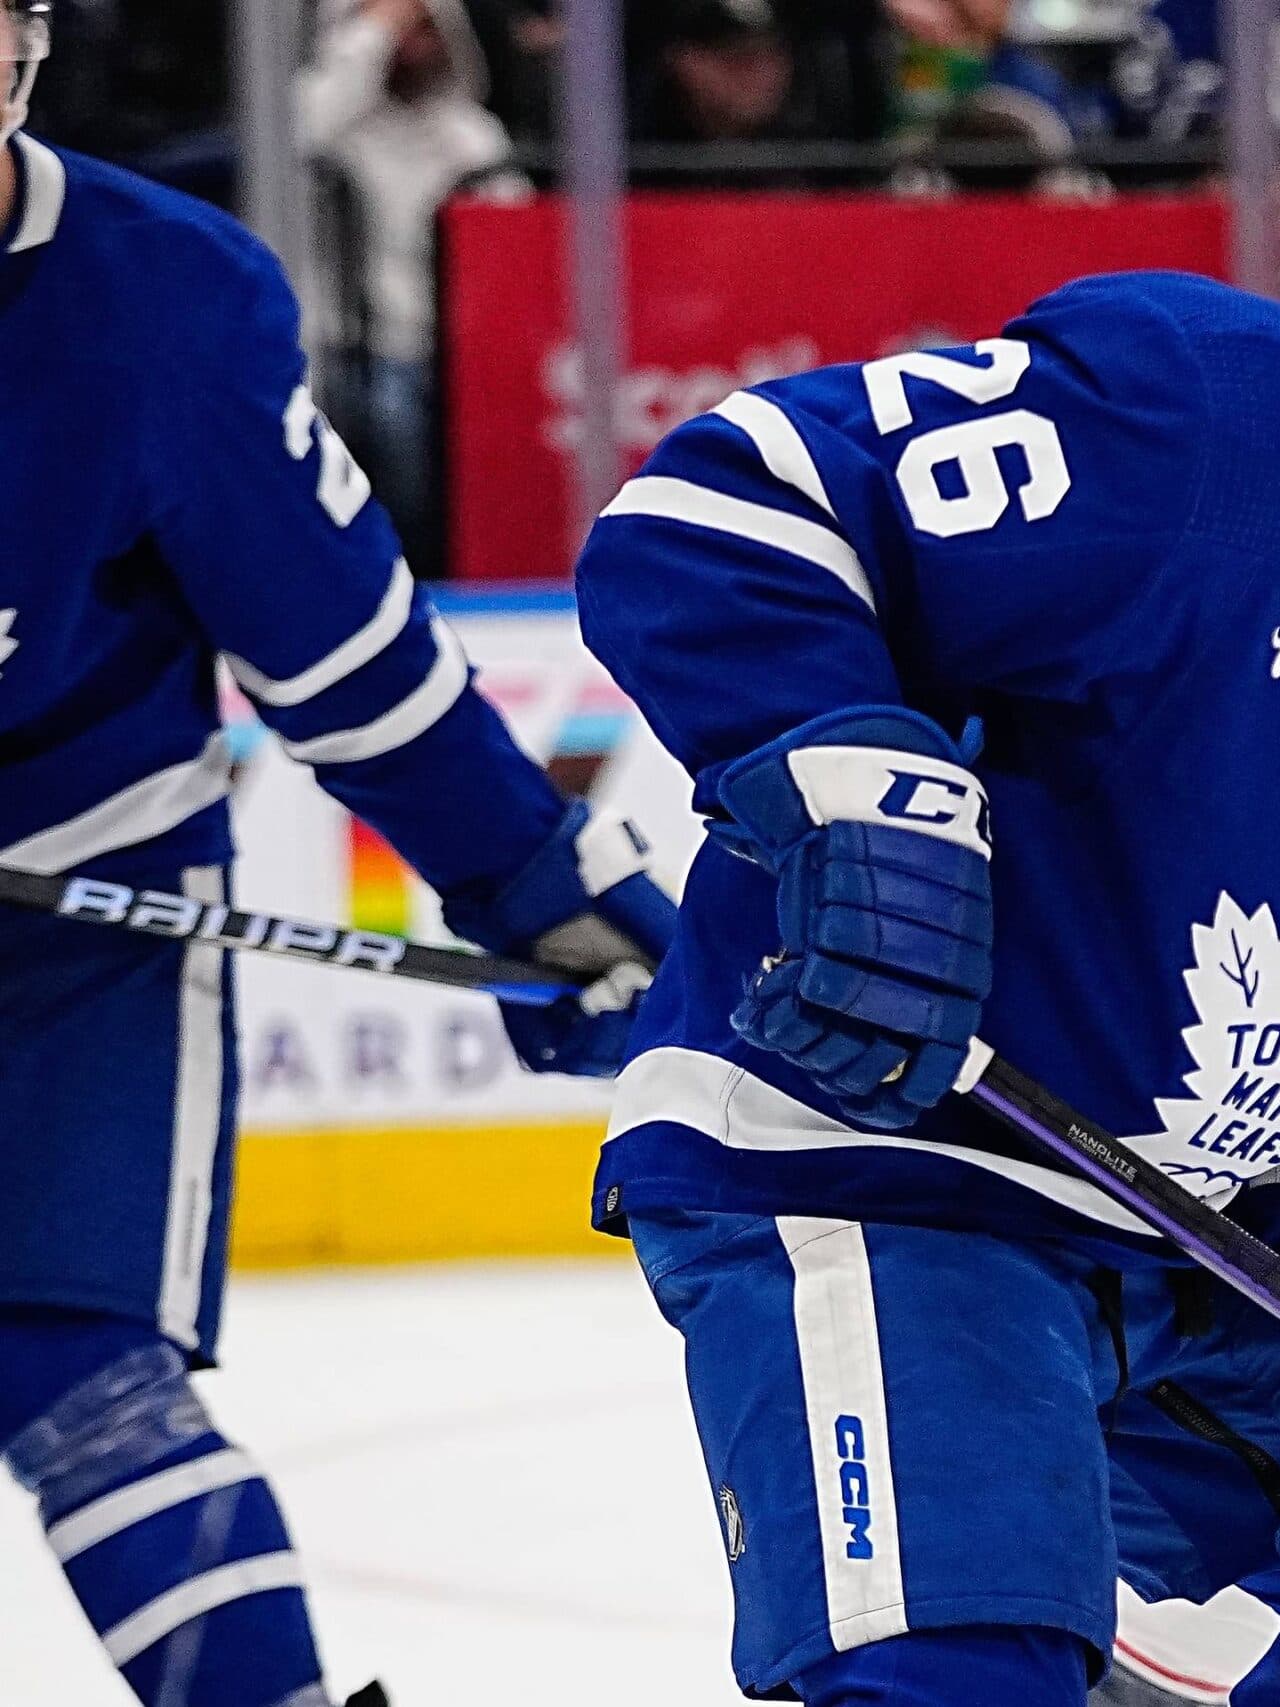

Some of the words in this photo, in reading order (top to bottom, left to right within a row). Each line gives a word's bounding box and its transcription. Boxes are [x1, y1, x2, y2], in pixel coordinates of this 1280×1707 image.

[862, 337, 1071, 539] 26
[54, 876, 406, 974] BAUER
[834, 1414, 874, 1560] CCM
